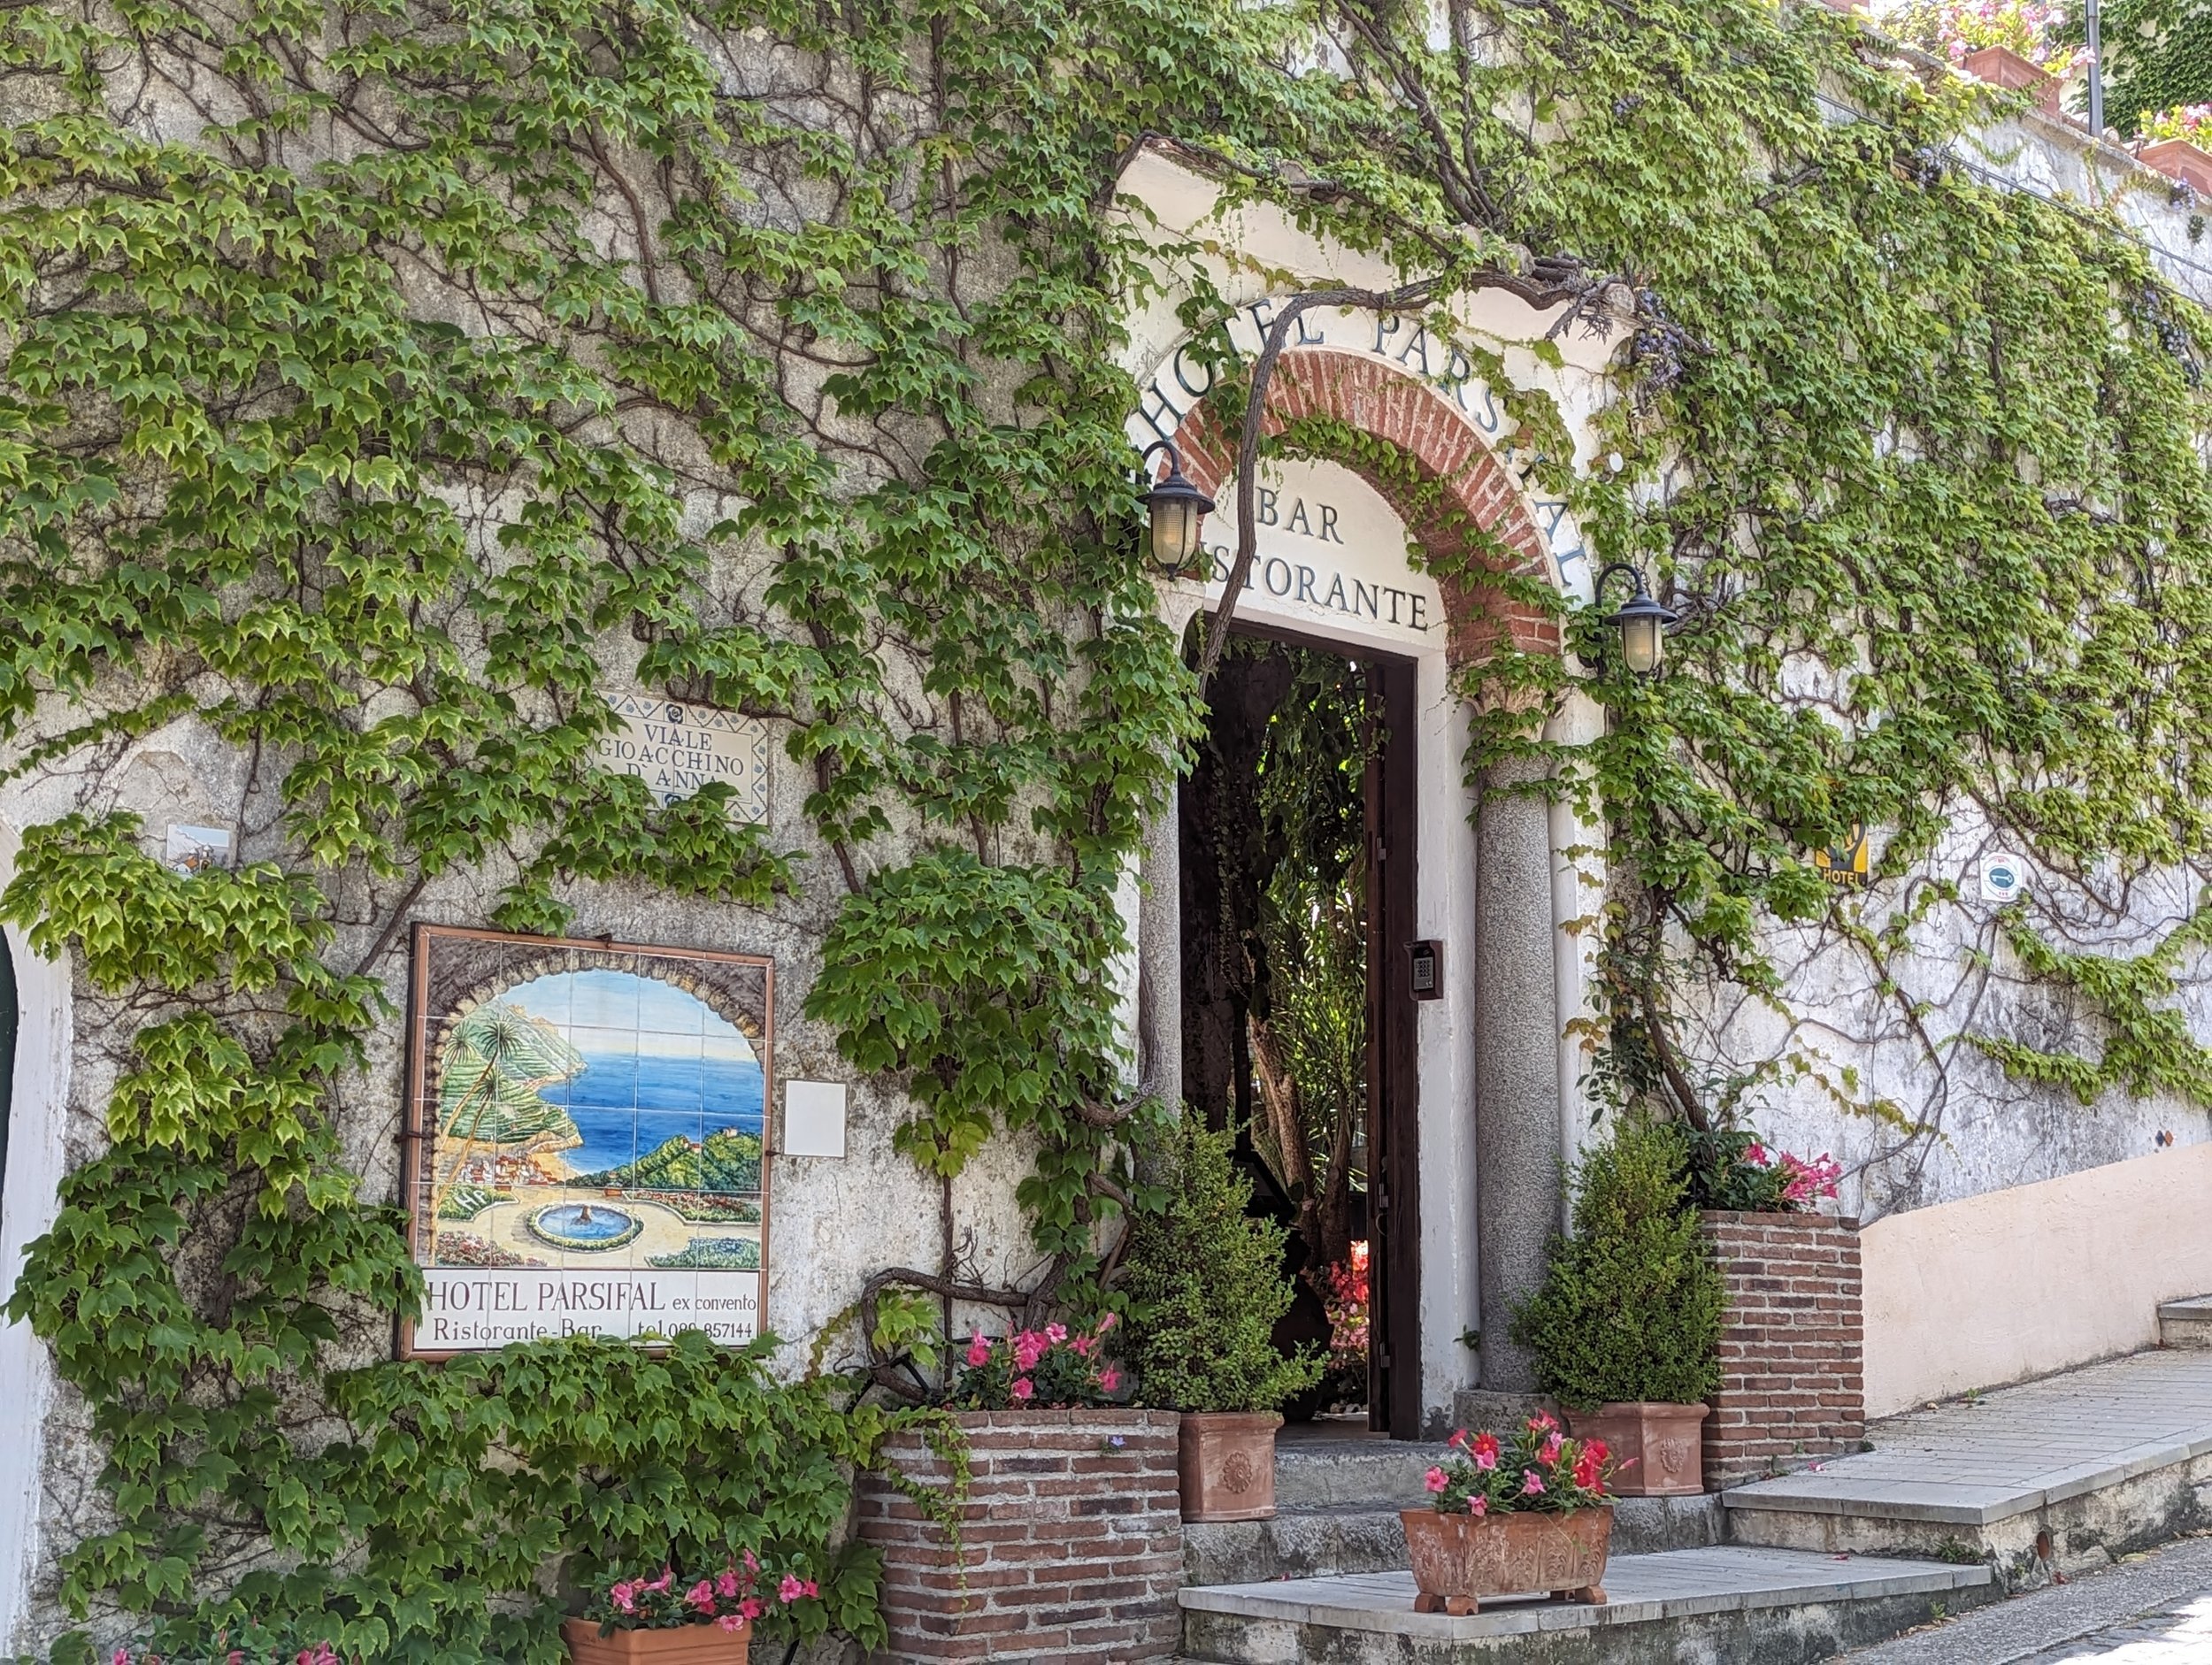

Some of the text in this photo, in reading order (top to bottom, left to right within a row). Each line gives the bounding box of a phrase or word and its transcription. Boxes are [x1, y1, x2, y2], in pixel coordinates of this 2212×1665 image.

[1372, 315, 1586, 586] PARSAL
[1257, 487, 1344, 545] BAR
[1200, 541, 1429, 632] STORANTE
[644, 724, 712, 751] VIALE
[598, 738, 744, 777] GIOACCHINO
[1823, 868, 1860, 885] HOTEL
[453, 1189, 486, 1211] HP
[428, 1281, 757, 1311] HOTEL PARSIFAL ex convento
[704, 1322, 752, 1339] 857144
